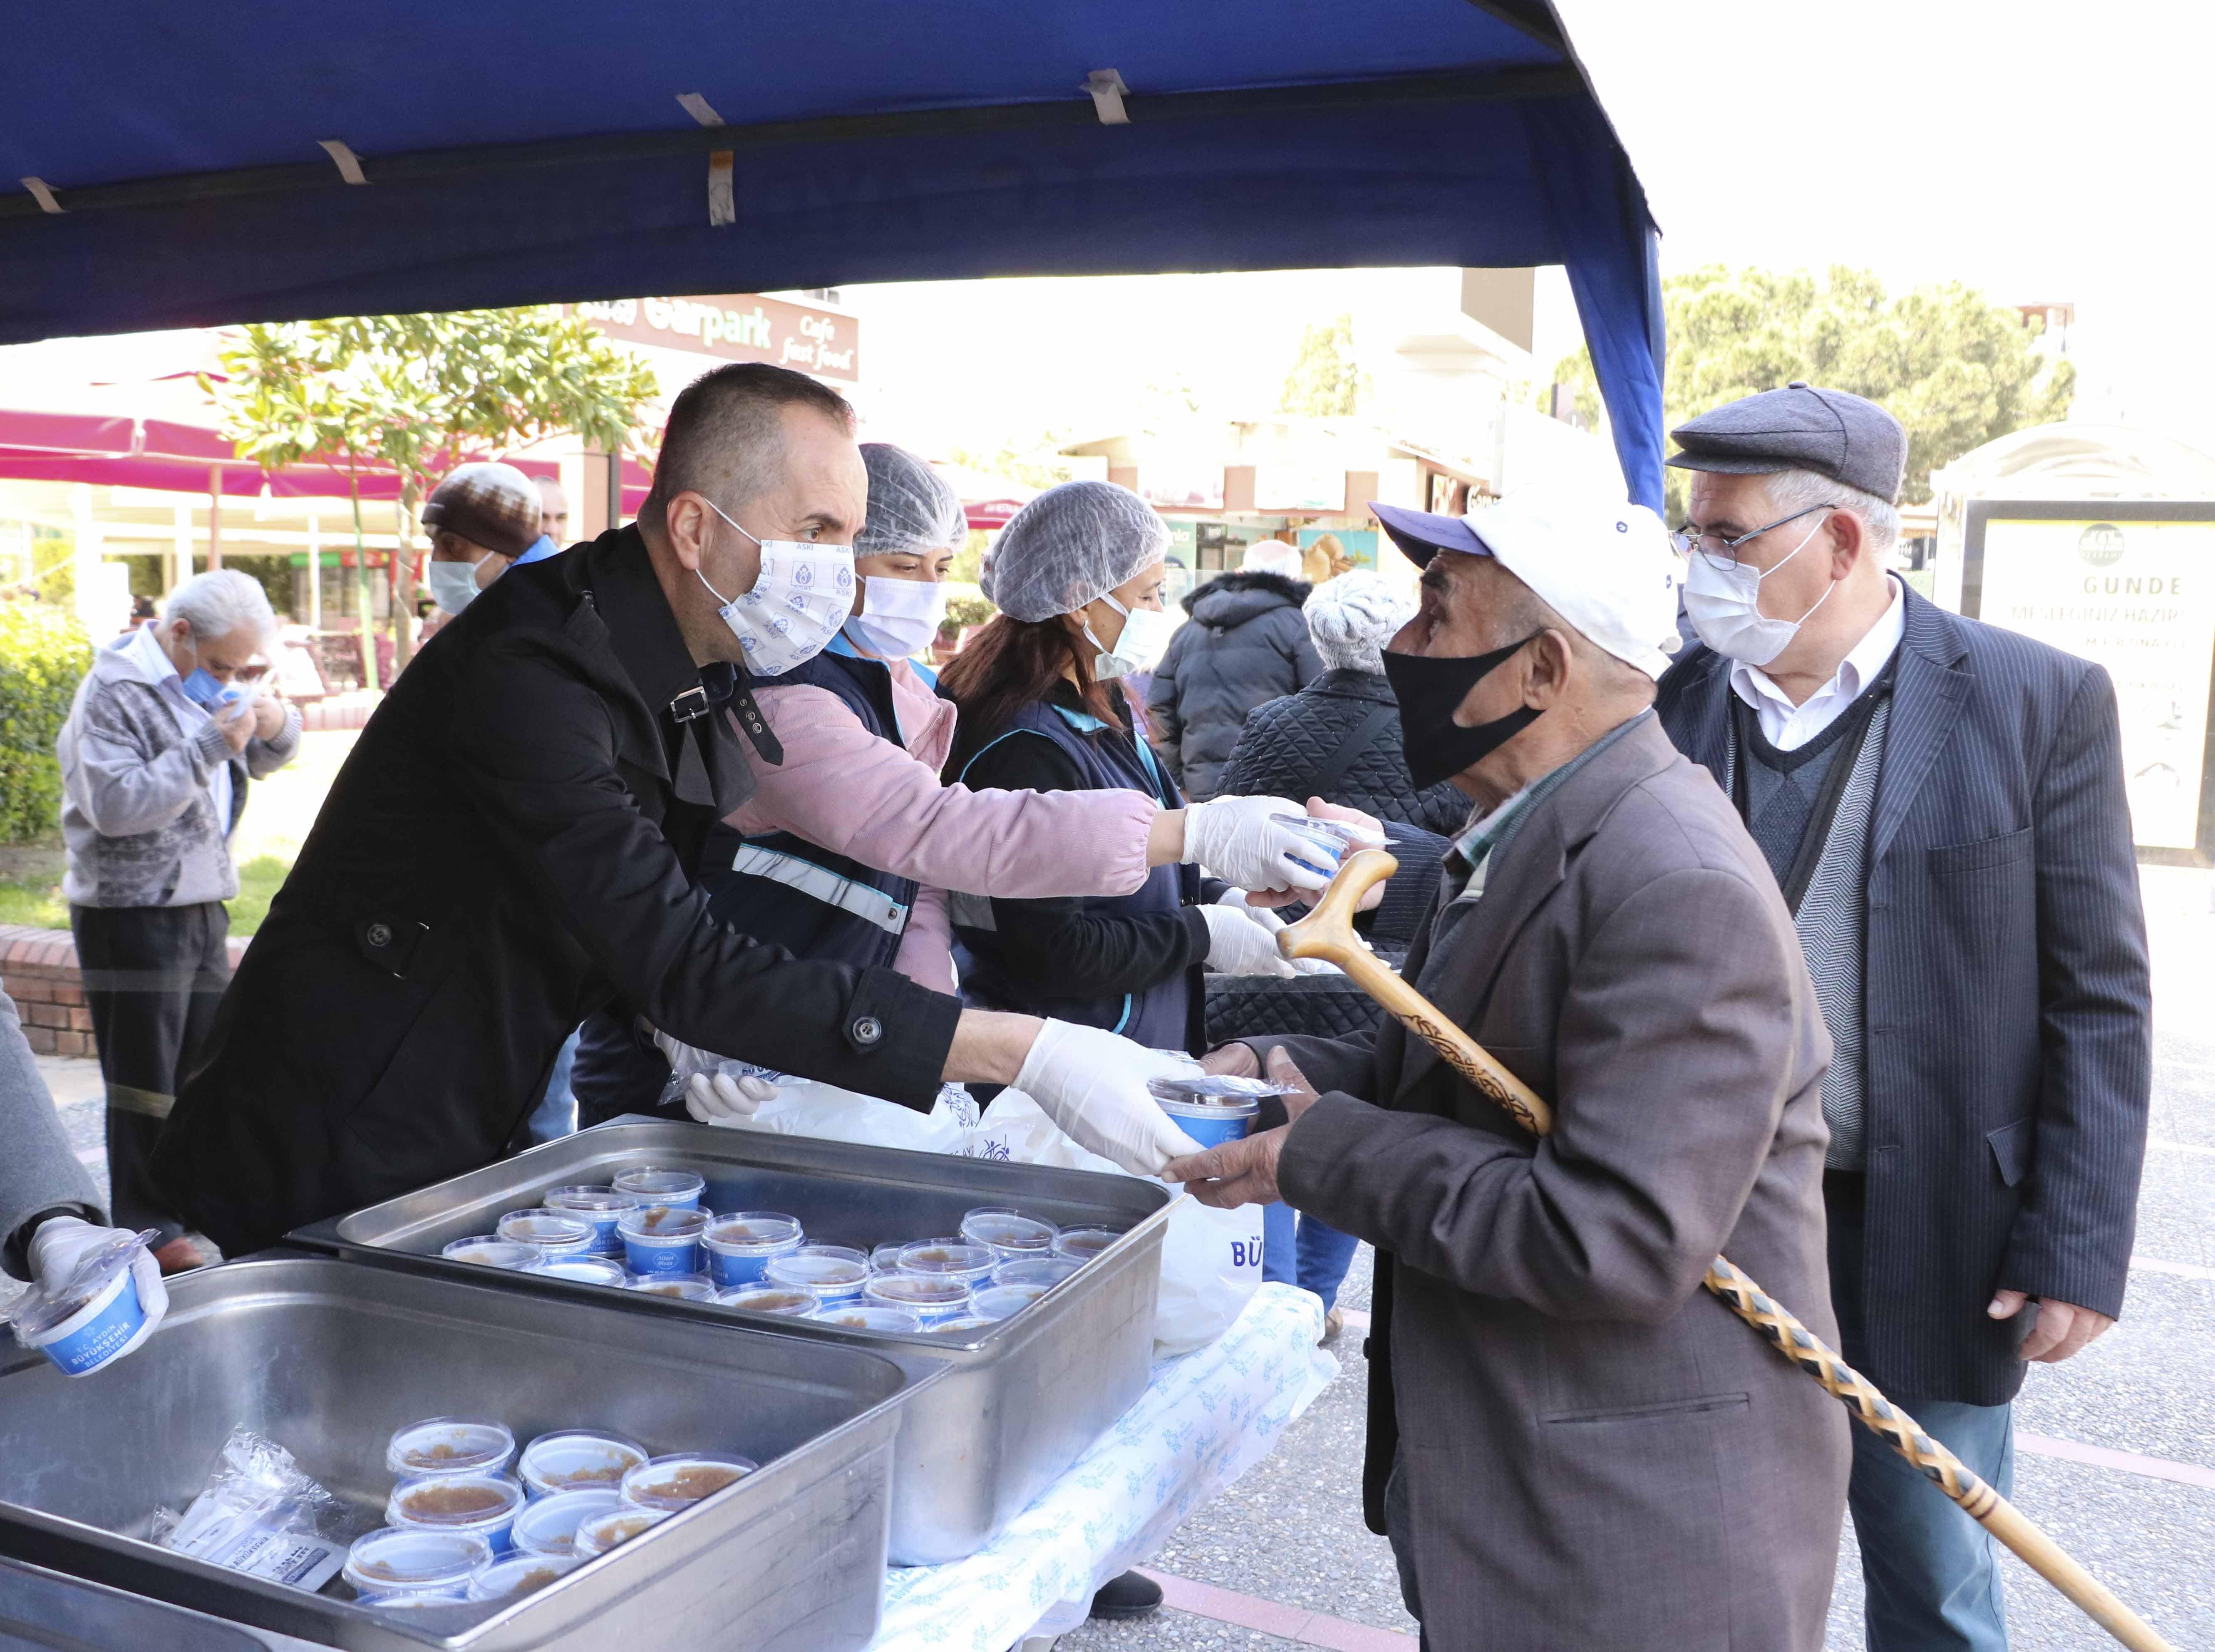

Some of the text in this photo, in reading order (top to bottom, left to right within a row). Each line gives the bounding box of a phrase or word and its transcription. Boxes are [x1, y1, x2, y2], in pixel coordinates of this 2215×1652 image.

[800, 315, 835, 345] Cafe
[778, 337, 854, 371] fast food
[1230, 1235, 1263, 1267] BÜ
